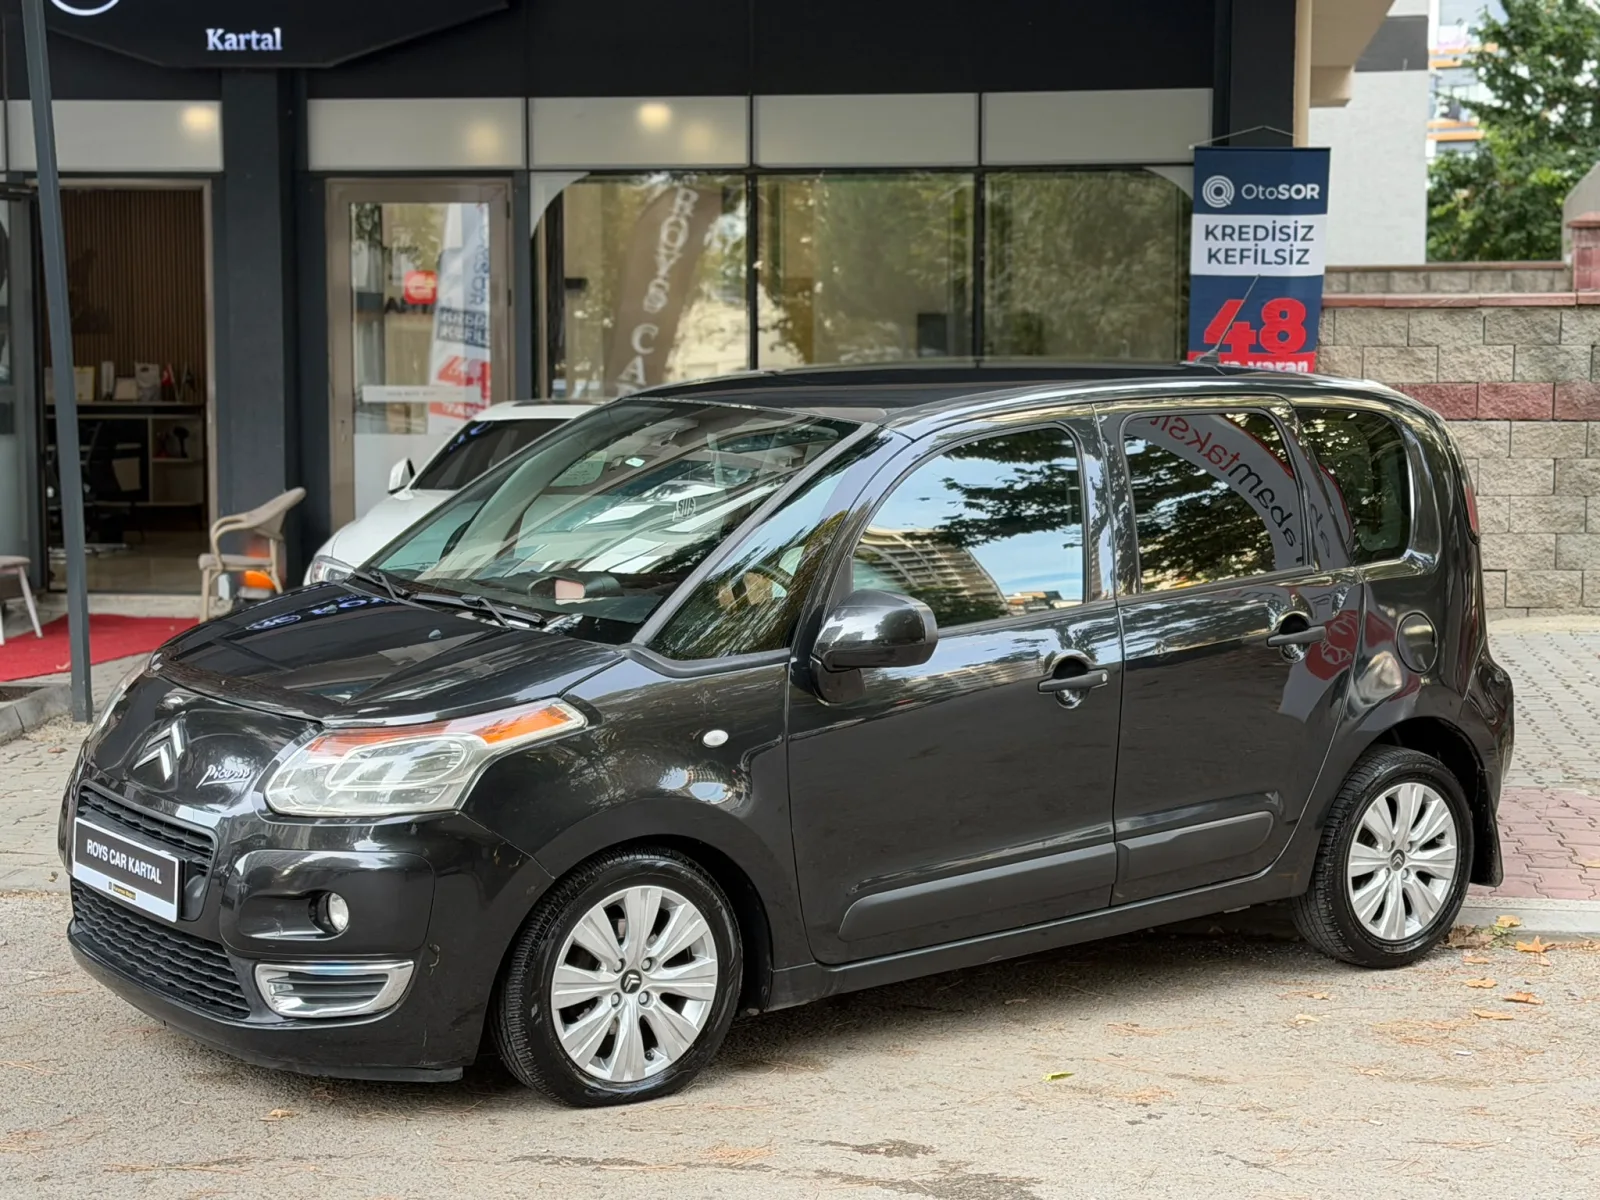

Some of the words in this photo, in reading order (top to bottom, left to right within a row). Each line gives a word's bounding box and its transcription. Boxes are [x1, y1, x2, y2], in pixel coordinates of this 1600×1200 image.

[205, 26, 283, 51] Kartal
[1240, 183, 1320, 200] OtoSOR
[1204, 220, 1315, 242] KREDİSİZ
[1207, 243, 1310, 265] KEFİLSİZ
[1203, 297, 1307, 355] 48
[86, 838, 108, 862] ROYS
[109, 848, 127, 870] CAR
[128, 857, 163, 885] KARTAL
